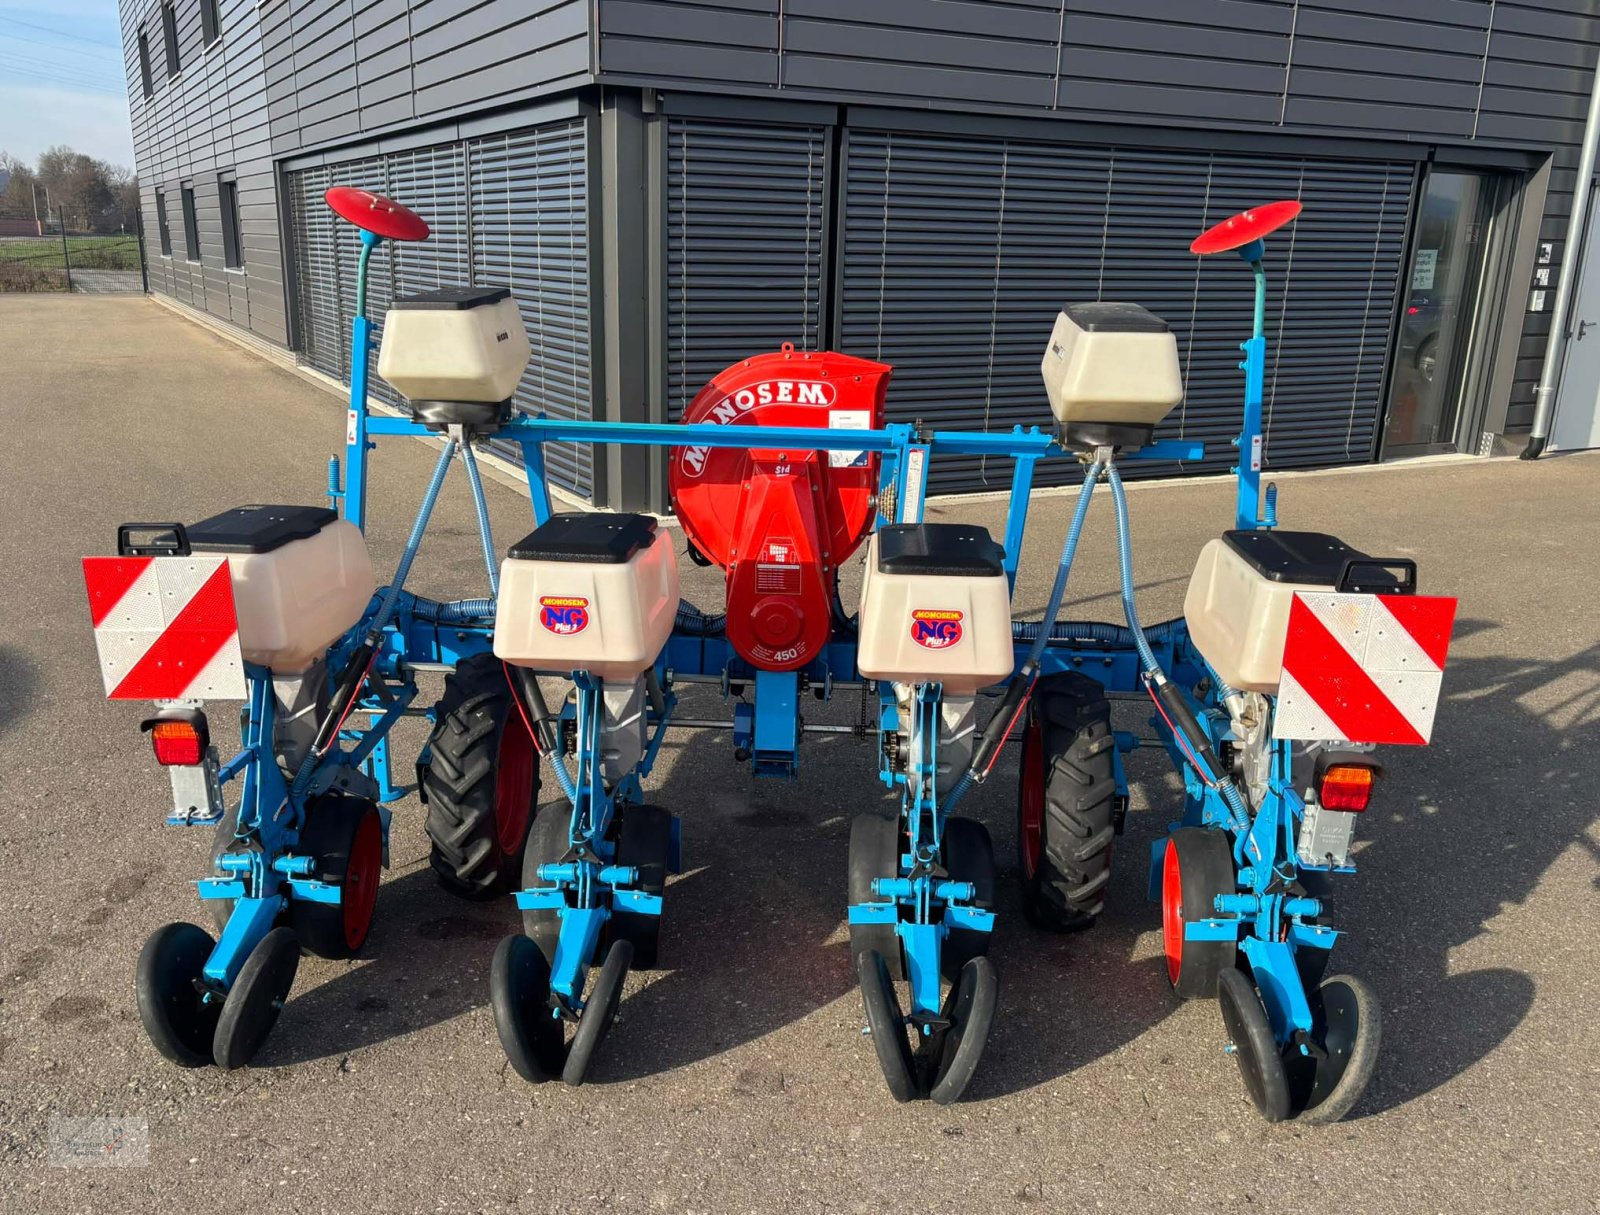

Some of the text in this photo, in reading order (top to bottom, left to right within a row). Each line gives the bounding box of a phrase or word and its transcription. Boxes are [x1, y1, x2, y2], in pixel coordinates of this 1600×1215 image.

[684, 381, 828, 473] MNOSEM
[543, 598, 586, 606] MONOSEM
[546, 607, 584, 627] NG
[915, 611, 960, 619] MONOSEM
[554, 622, 571, 632] Plus
[917, 620, 957, 641] NG
[925, 636, 943, 646] Plus
[773, 648, 797, 661] 450
